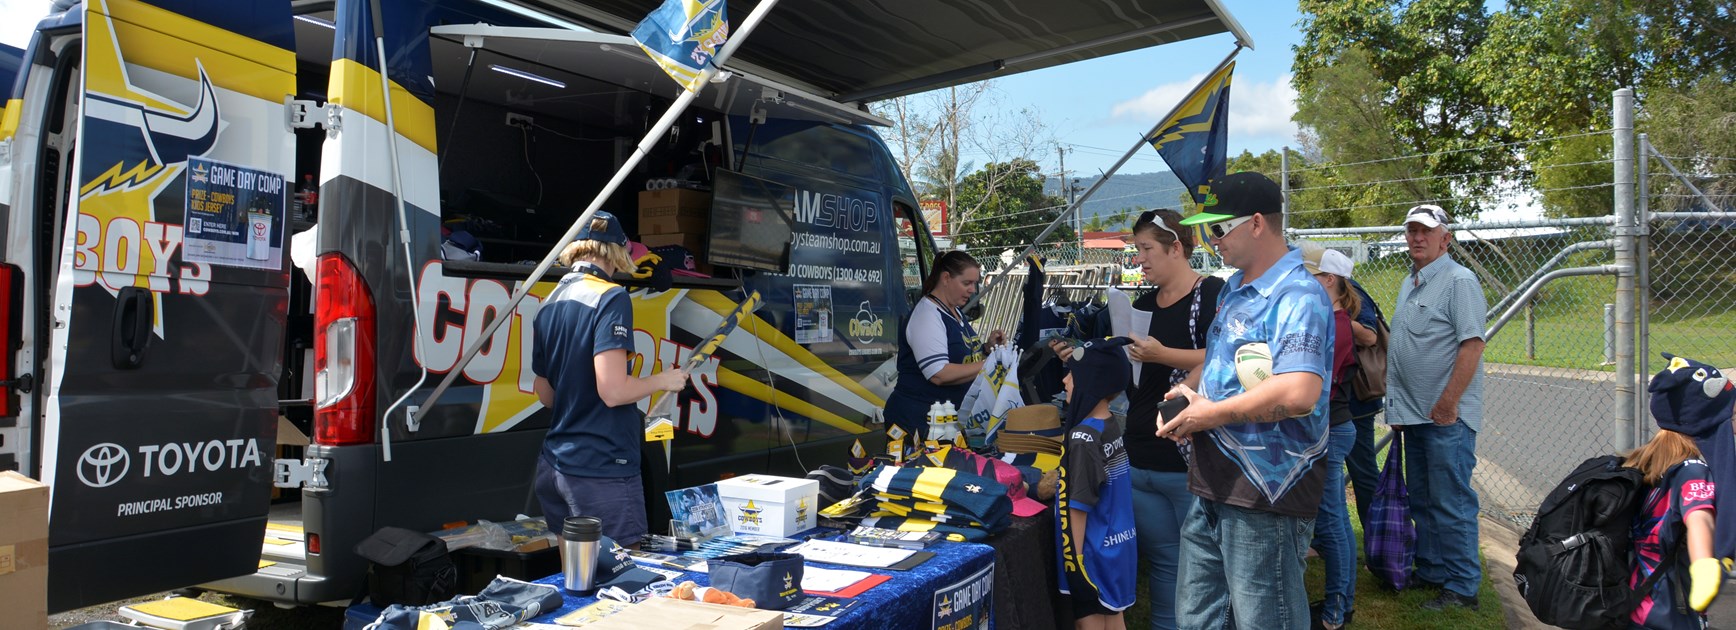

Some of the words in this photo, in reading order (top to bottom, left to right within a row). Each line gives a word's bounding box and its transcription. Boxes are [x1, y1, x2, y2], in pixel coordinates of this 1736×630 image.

[211, 165, 235, 188] GAME
[237, 170, 257, 191] DAY
[257, 174, 281, 195] COMP
[191, 188, 207, 200] PRIZE
[210, 191, 235, 205] COWBOYS
[191, 199, 204, 211] KIDS
[797, 264, 833, 280] COWBOYS
[833, 265, 853, 282] (1300
[853, 268, 868, 282] 462
[867, 269, 883, 285] 692)
[849, 318, 883, 337] COWBOYS
[139, 438, 261, 477] TOYOTA
[117, 498, 173, 517] PRINCIPAL
[174, 491, 223, 509] SPONSOR
[1103, 530, 1128, 547] SHINE
[954, 586, 971, 612] GAME
